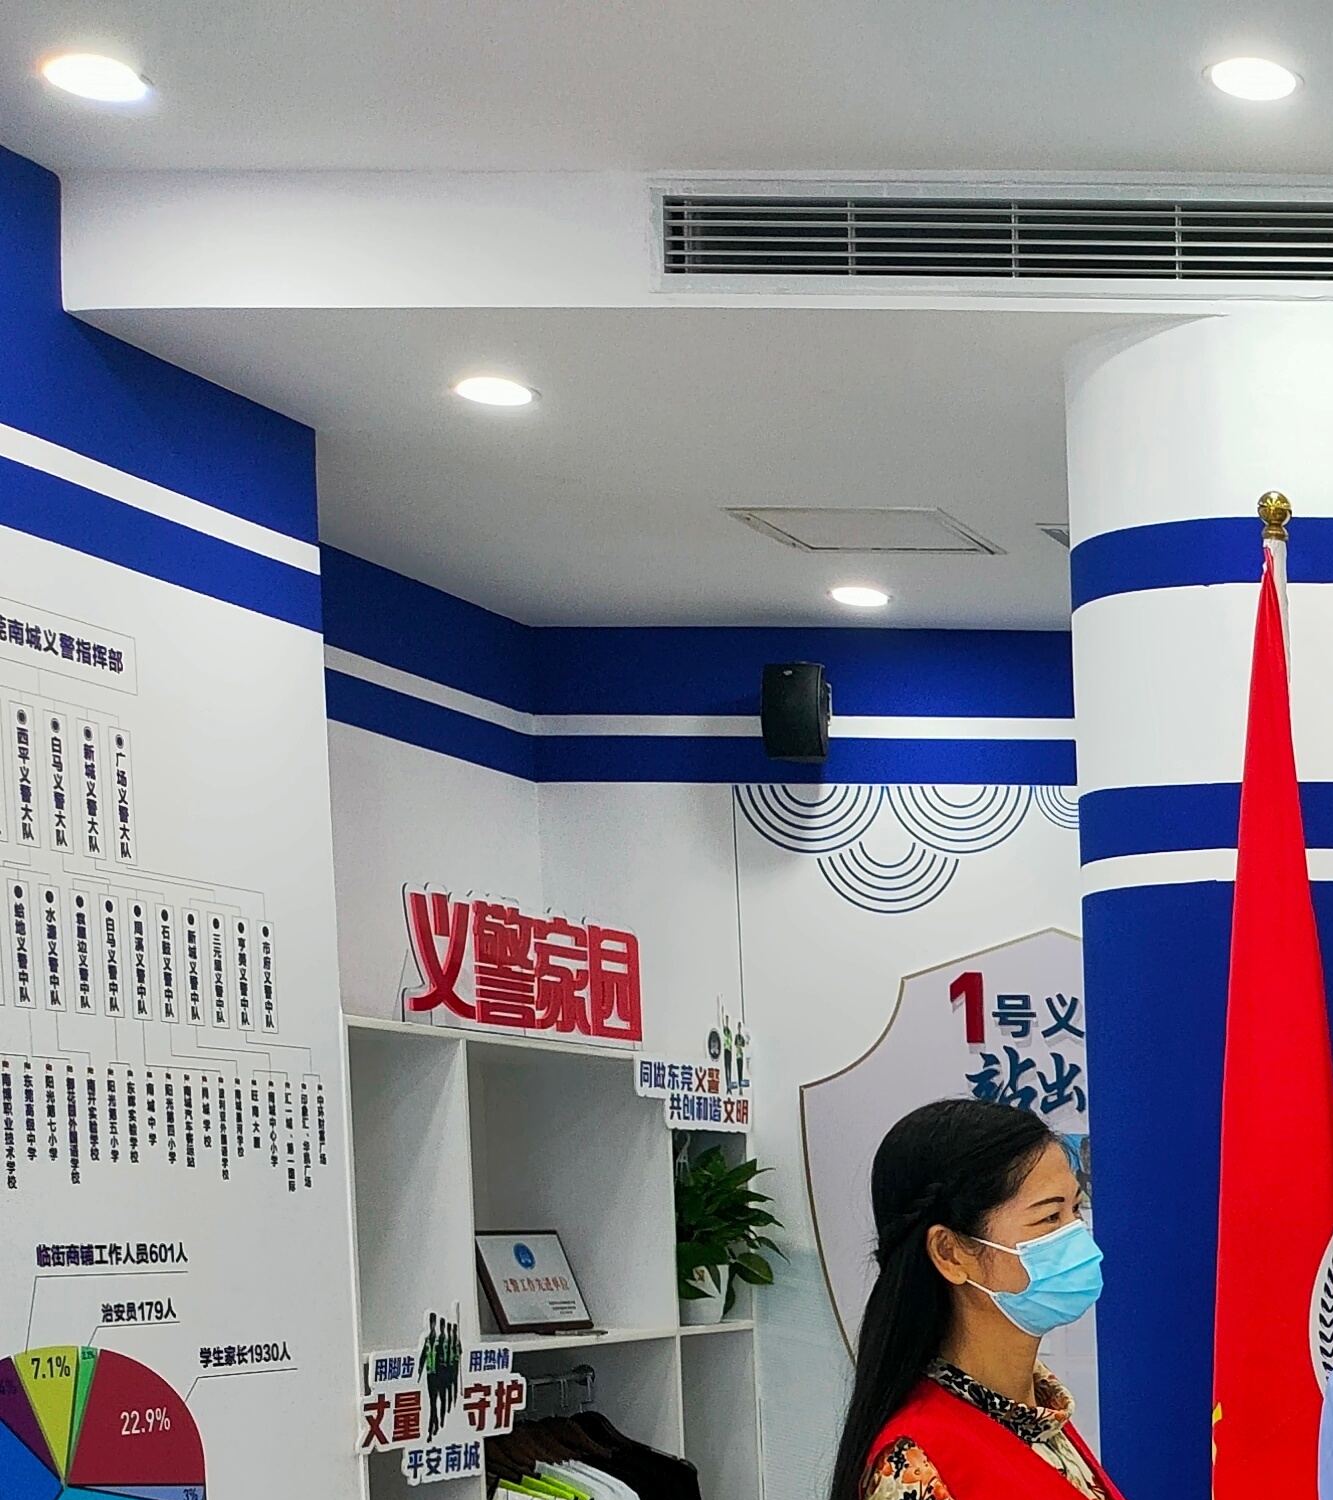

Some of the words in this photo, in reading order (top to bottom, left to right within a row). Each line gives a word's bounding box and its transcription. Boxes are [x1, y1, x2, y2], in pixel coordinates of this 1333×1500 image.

[16, 727, 34, 840] 西平义警大队
[50, 737, 68, 847] 白马义警大队
[83, 743, 100, 853] 新城义警大队
[115, 752, 132, 859] 广场义警大队
[408, 892, 642, 1042] 义警家园
[950, 972, 1084, 1043] 1号义
[669, 1093, 749, 1125] 共创和谐文明
[36, 1242, 188, 1267] 临街商铺工作人员601人
[101, 1298, 177, 1323] 治安员179人
[31, 1355, 71, 1379] 7.1%
[199, 1341, 291, 1368] 学生家长1930人
[374, 1355, 415, 1382] 用脚步
[469, 1348, 510, 1373] 用热情
[120, 1407, 171, 1435] 22.9%
[362, 1391, 421, 1449] 丈量
[463, 1380, 524, 1431] 守护
[407, 1441, 480, 1479] 平安南城
